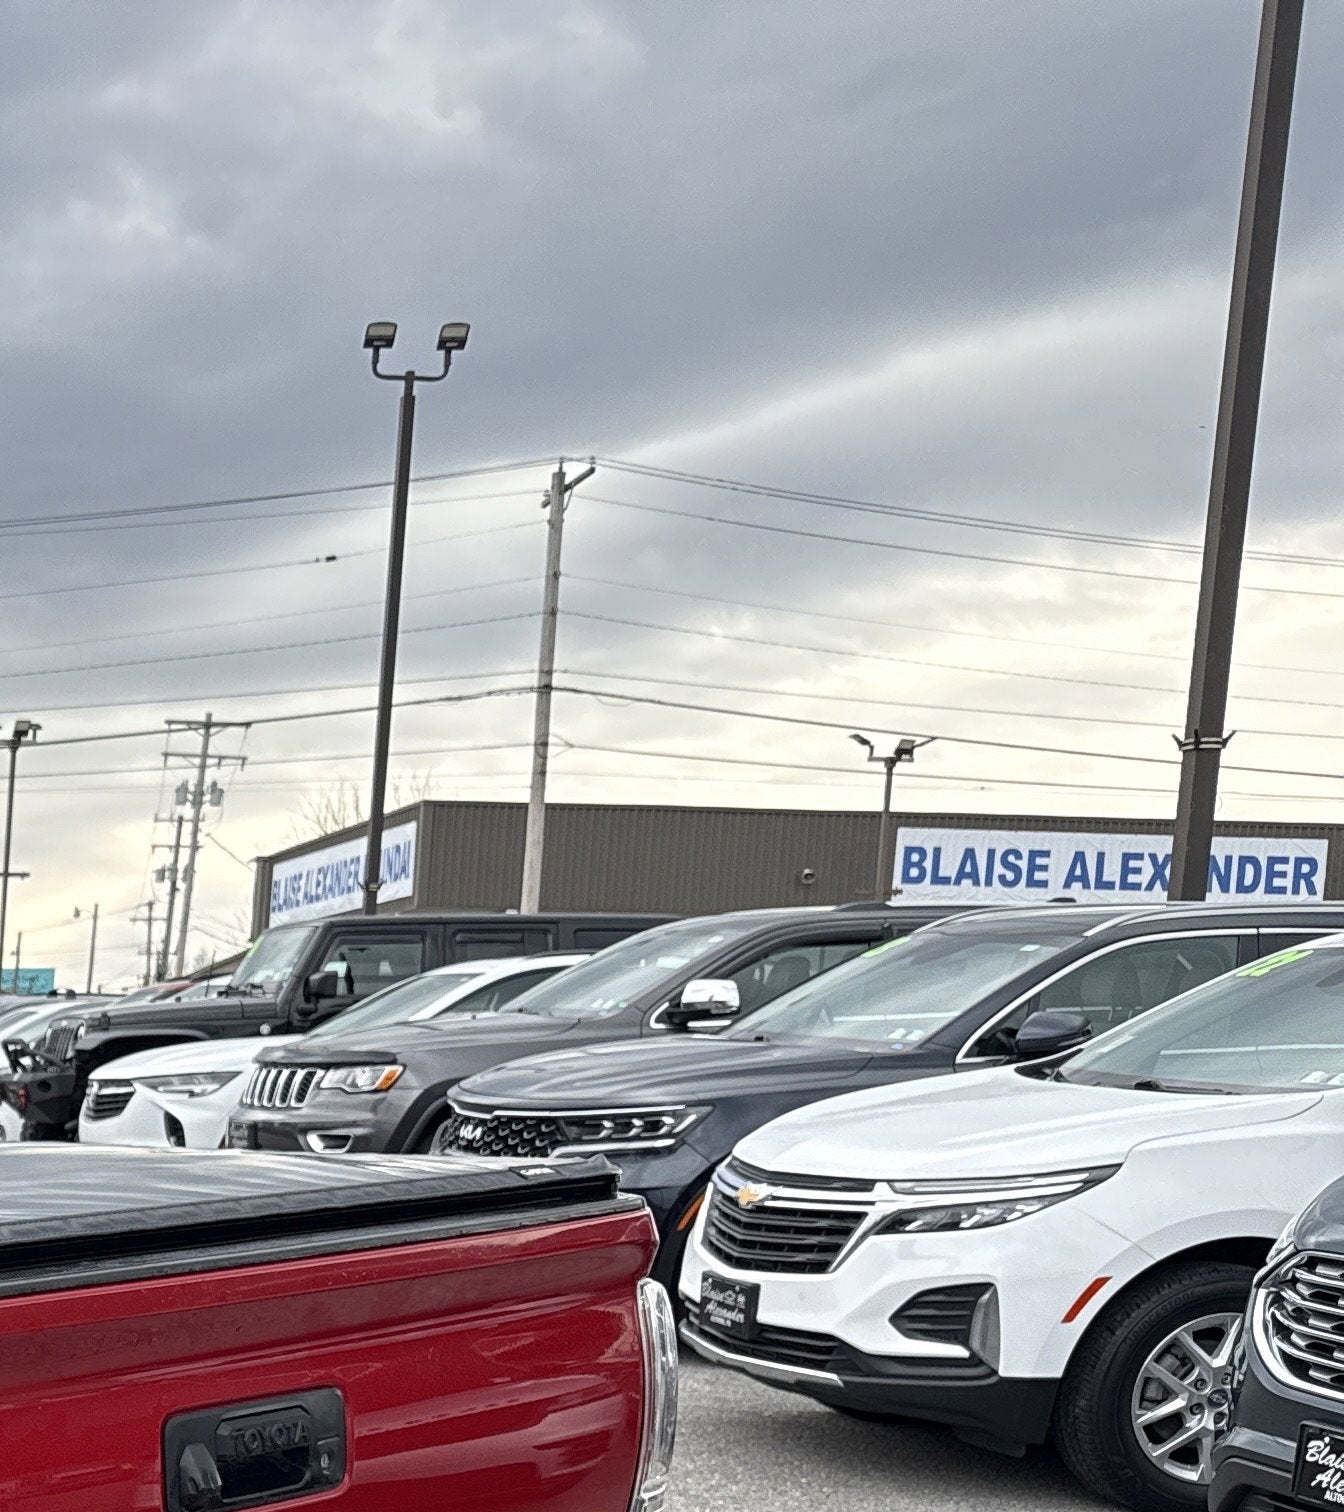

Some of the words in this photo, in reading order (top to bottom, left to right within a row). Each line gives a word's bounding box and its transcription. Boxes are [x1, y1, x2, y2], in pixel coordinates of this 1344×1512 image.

[272, 872, 303, 912] BLAISE
[302, 855, 361, 905] ALEXANDER
[900, 846, 1051, 888] BLAISE
[1063, 850, 1319, 896] ALEXNDER
[231, 1419, 310, 1457] TOYOTA
[1305, 1440, 1344, 1471] Blai
